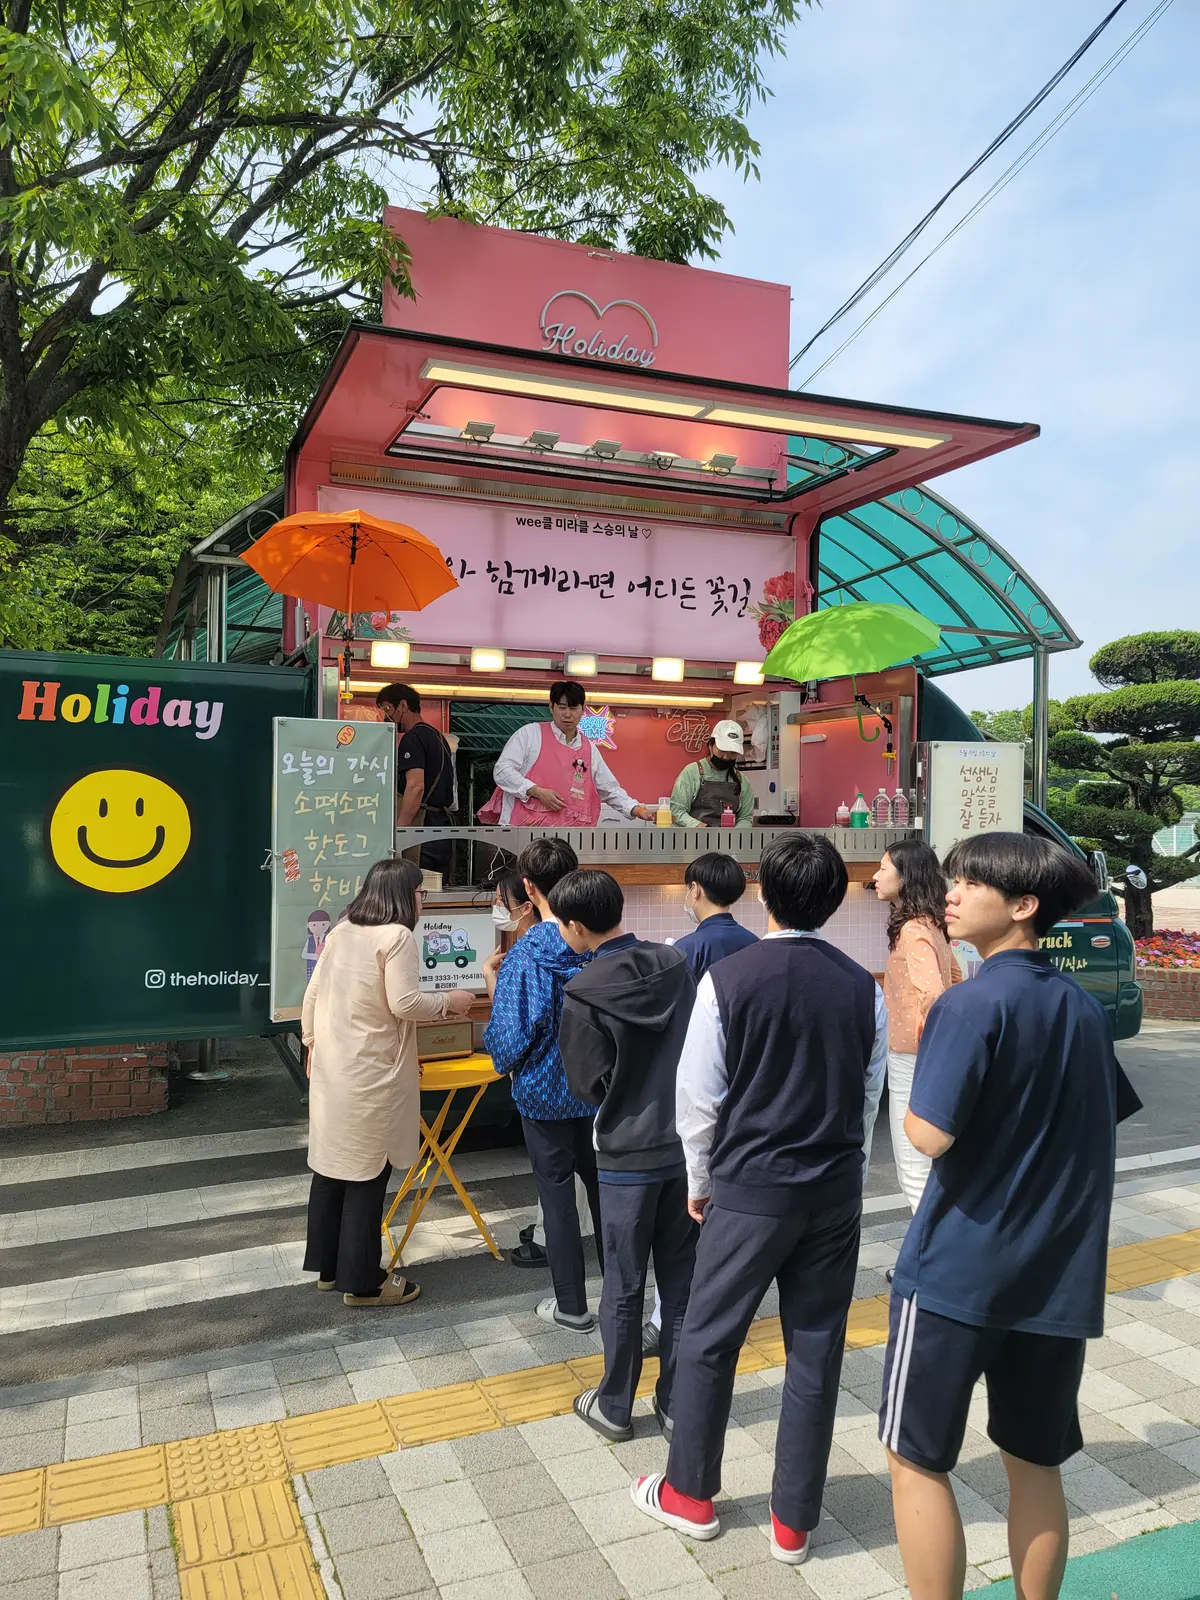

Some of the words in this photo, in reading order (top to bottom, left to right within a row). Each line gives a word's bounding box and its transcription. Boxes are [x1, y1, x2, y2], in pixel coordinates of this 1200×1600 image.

[541, 323, 656, 368] Holiday
[515, 516, 553, 530] wee클
[555, 518, 589, 533] 미라클
[592, 523, 625, 537] 스승의
[628, 525, 639, 539] 날
[486, 560, 615, 599] 함께라면
[628, 575, 697, 610] 어디든
[705, 577, 752, 617] 꽃길
[17, 680, 224, 740] Holiday
[281, 750, 335, 786] 오늘의
[346, 755, 389, 786] 간식
[959, 765, 999, 784] 선생님
[294, 790, 380, 825] 소떡소떡
[961, 785, 997, 809] 말씀을
[959, 808, 973, 830] 잘
[978, 807, 1002, 829] 듣자
[304, 829, 370, 865] 핫도그
[308, 871, 363, 907] 핫바
[423, 922, 453, 932] Holiday
[1037, 931, 1073, 949] ruck
[434, 982, 458, 990] 홀리데이
